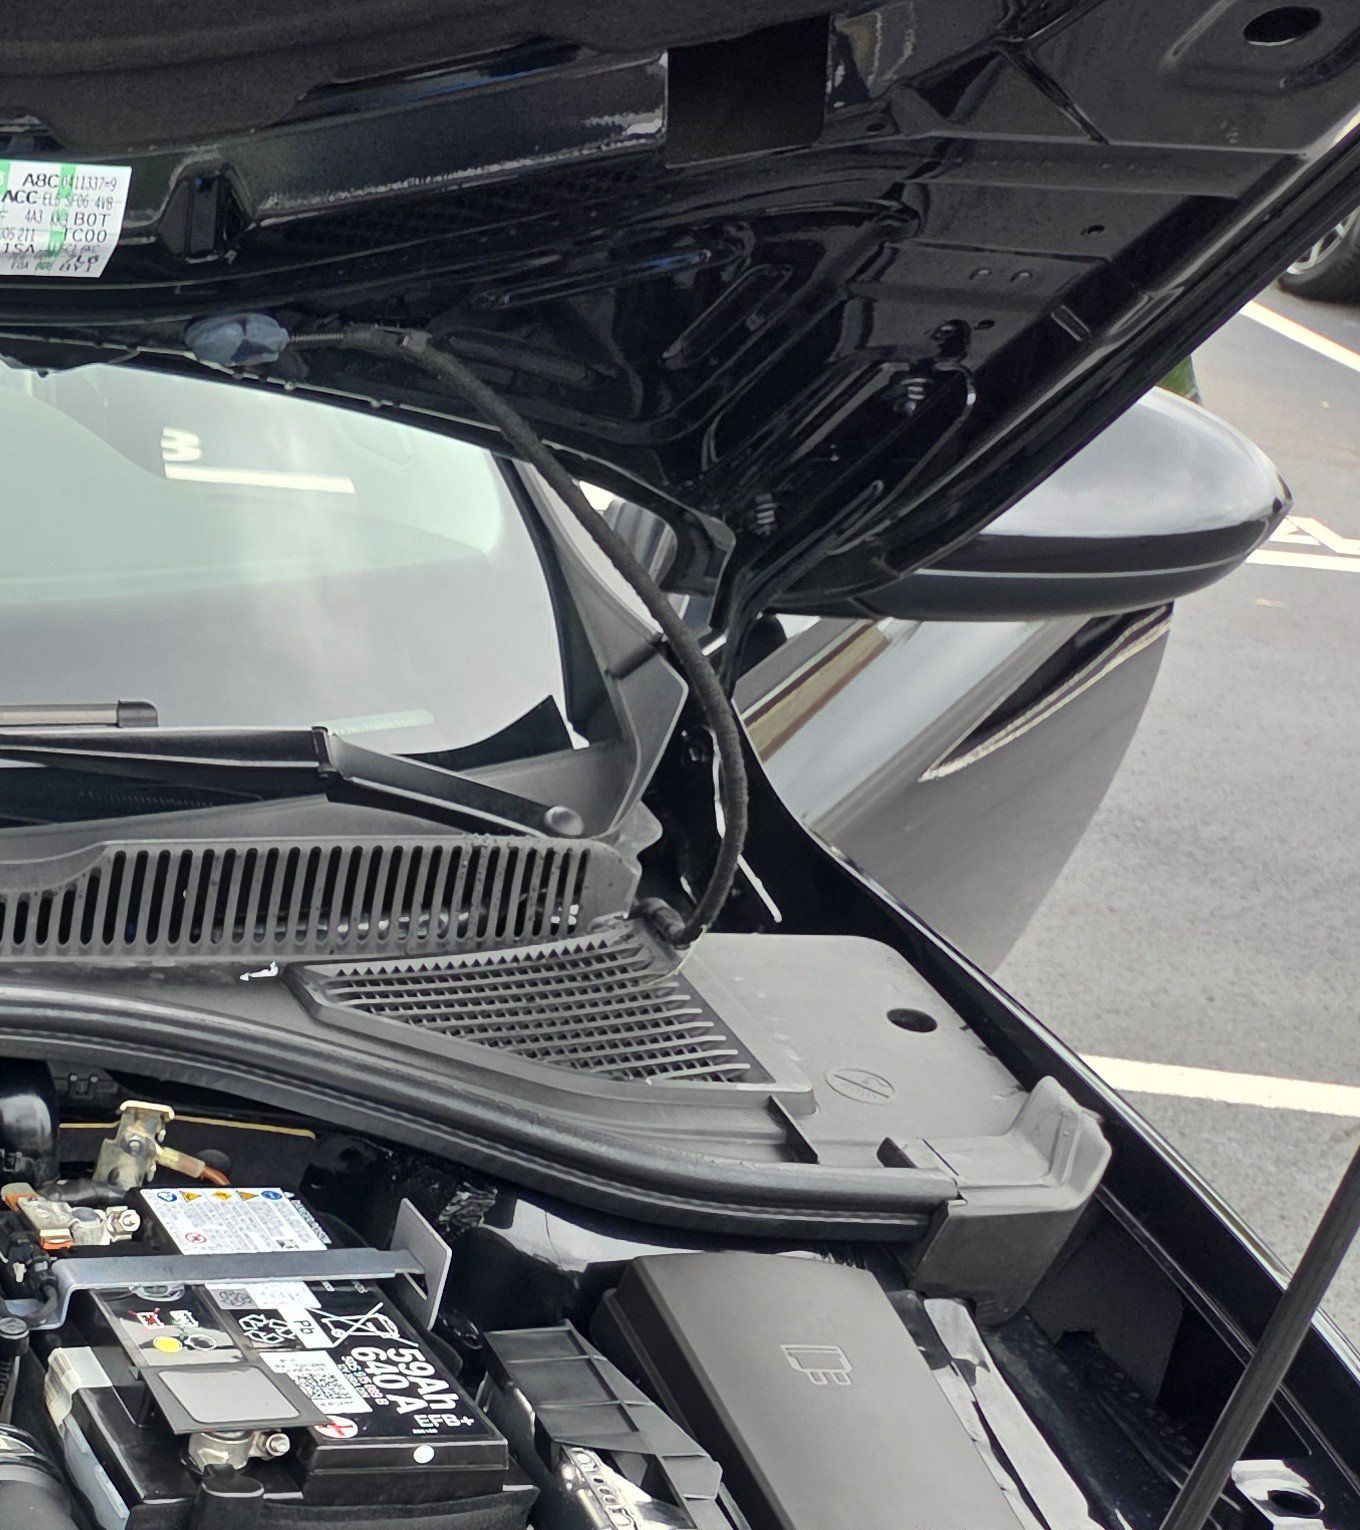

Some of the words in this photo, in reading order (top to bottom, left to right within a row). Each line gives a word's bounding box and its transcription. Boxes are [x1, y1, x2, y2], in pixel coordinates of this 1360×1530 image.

[350, 1346, 410, 1390] 640
[385, 1393, 428, 1414] A
[386, 1347, 459, 1410] 59Ah
[413, 1414, 475, 1428] EFB+
